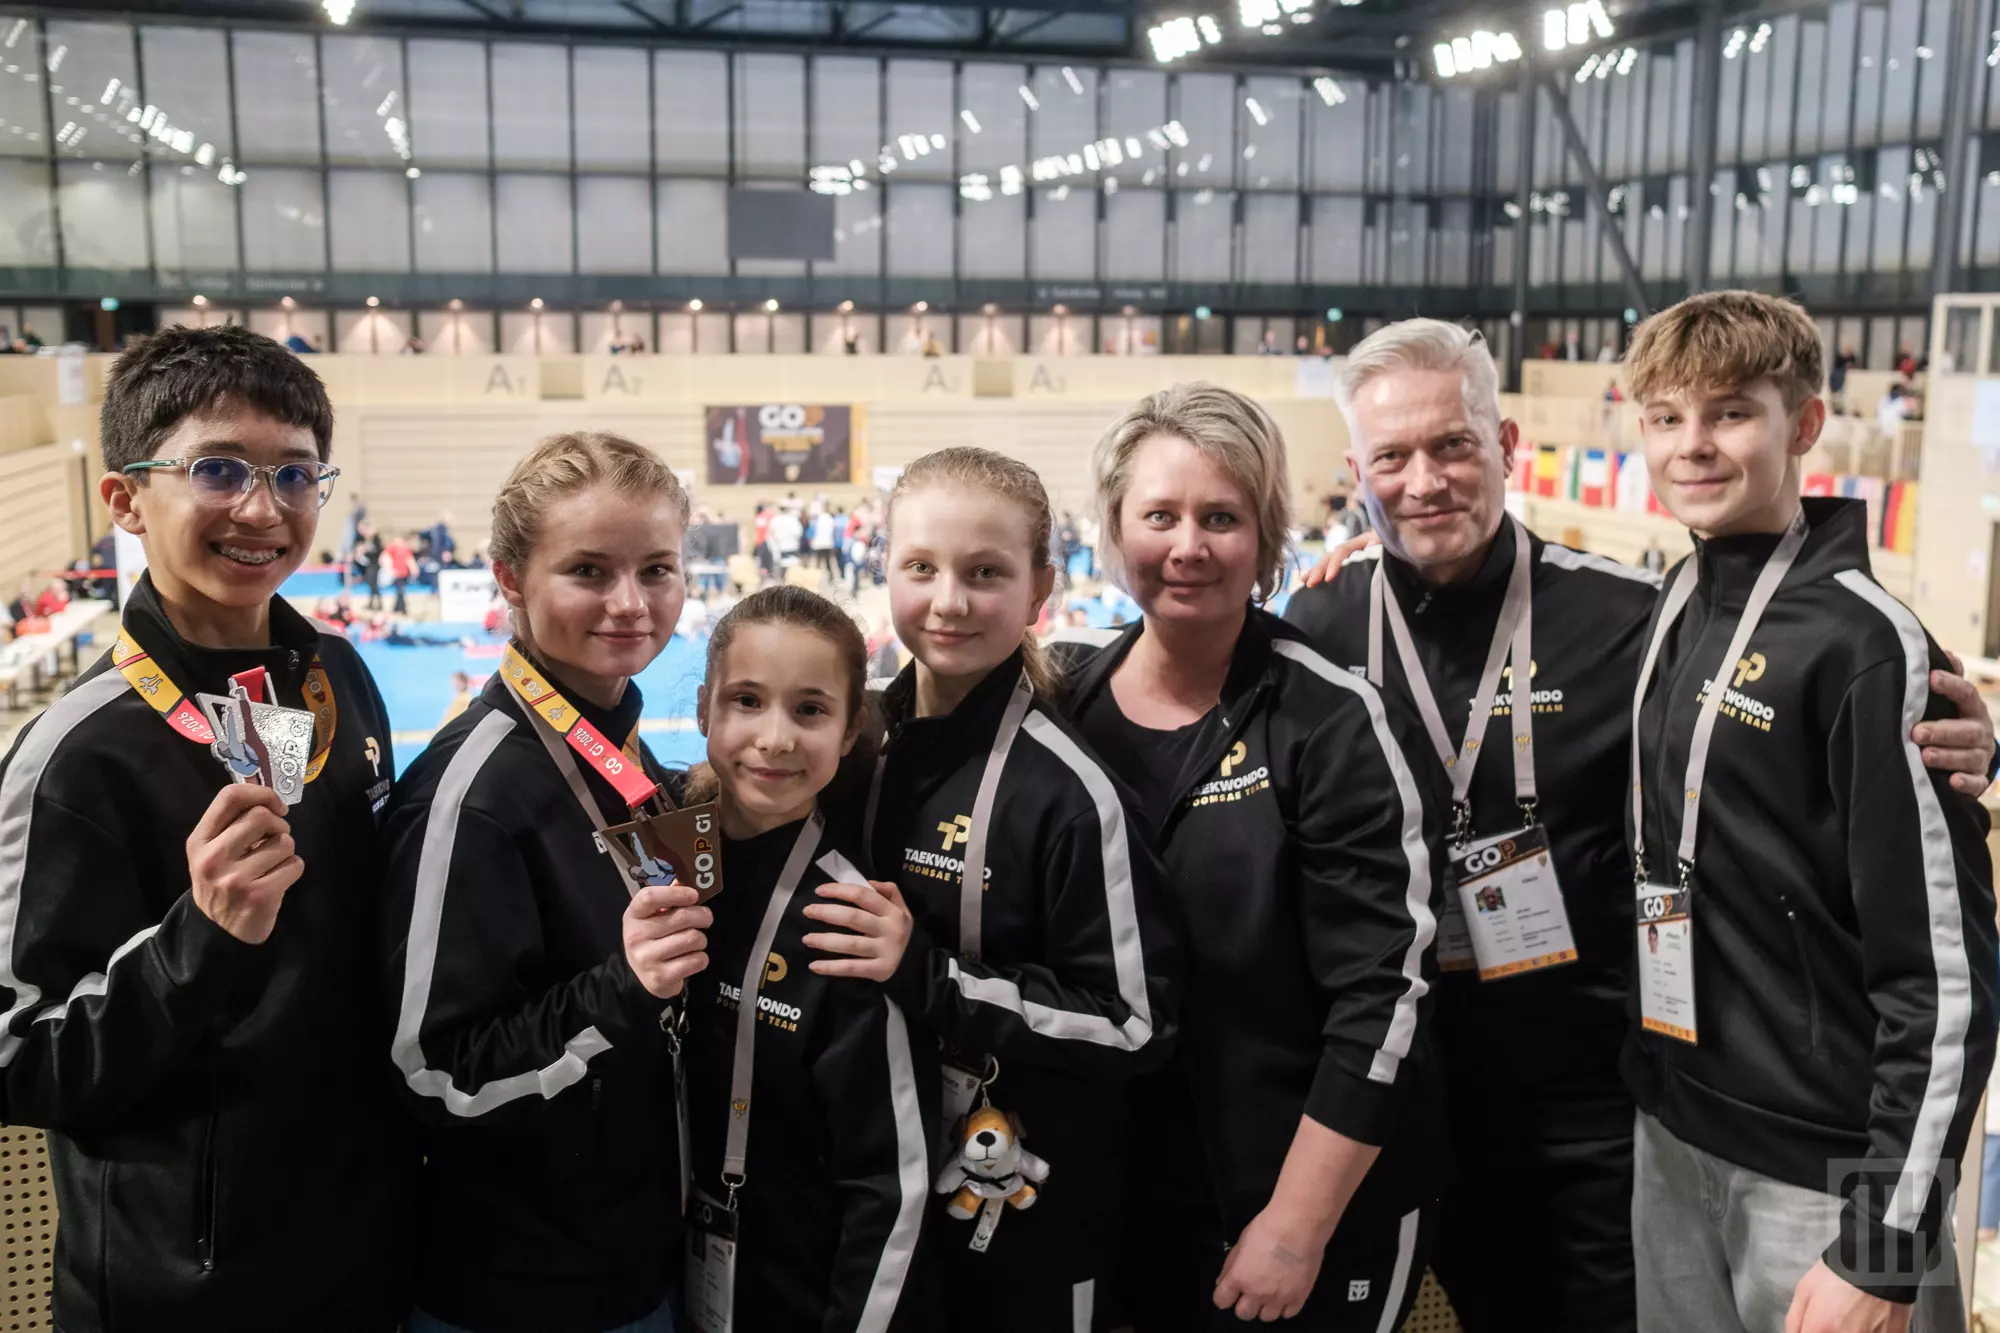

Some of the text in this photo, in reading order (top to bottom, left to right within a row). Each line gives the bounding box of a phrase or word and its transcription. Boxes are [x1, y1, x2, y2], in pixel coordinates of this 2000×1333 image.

[177, 711, 204, 733] 2026
[1740, 711, 1772, 733] TEAM
[573, 727, 594, 747] 2026
[588, 741, 605, 757] G1
[277, 739, 302, 796] GOP
[1192, 780, 1270, 807] OOMSAE TEAM
[693, 813, 716, 890] GOP G1
[1464, 839, 1517, 874] GOP
[902, 863, 951, 882] POOMSAE
[903, 848, 992, 880] TAEKWONO
[1643, 895, 1674, 919] GOP
[719, 981, 802, 1021] TAEONDO
[768, 1014, 798, 1033] TEAM
